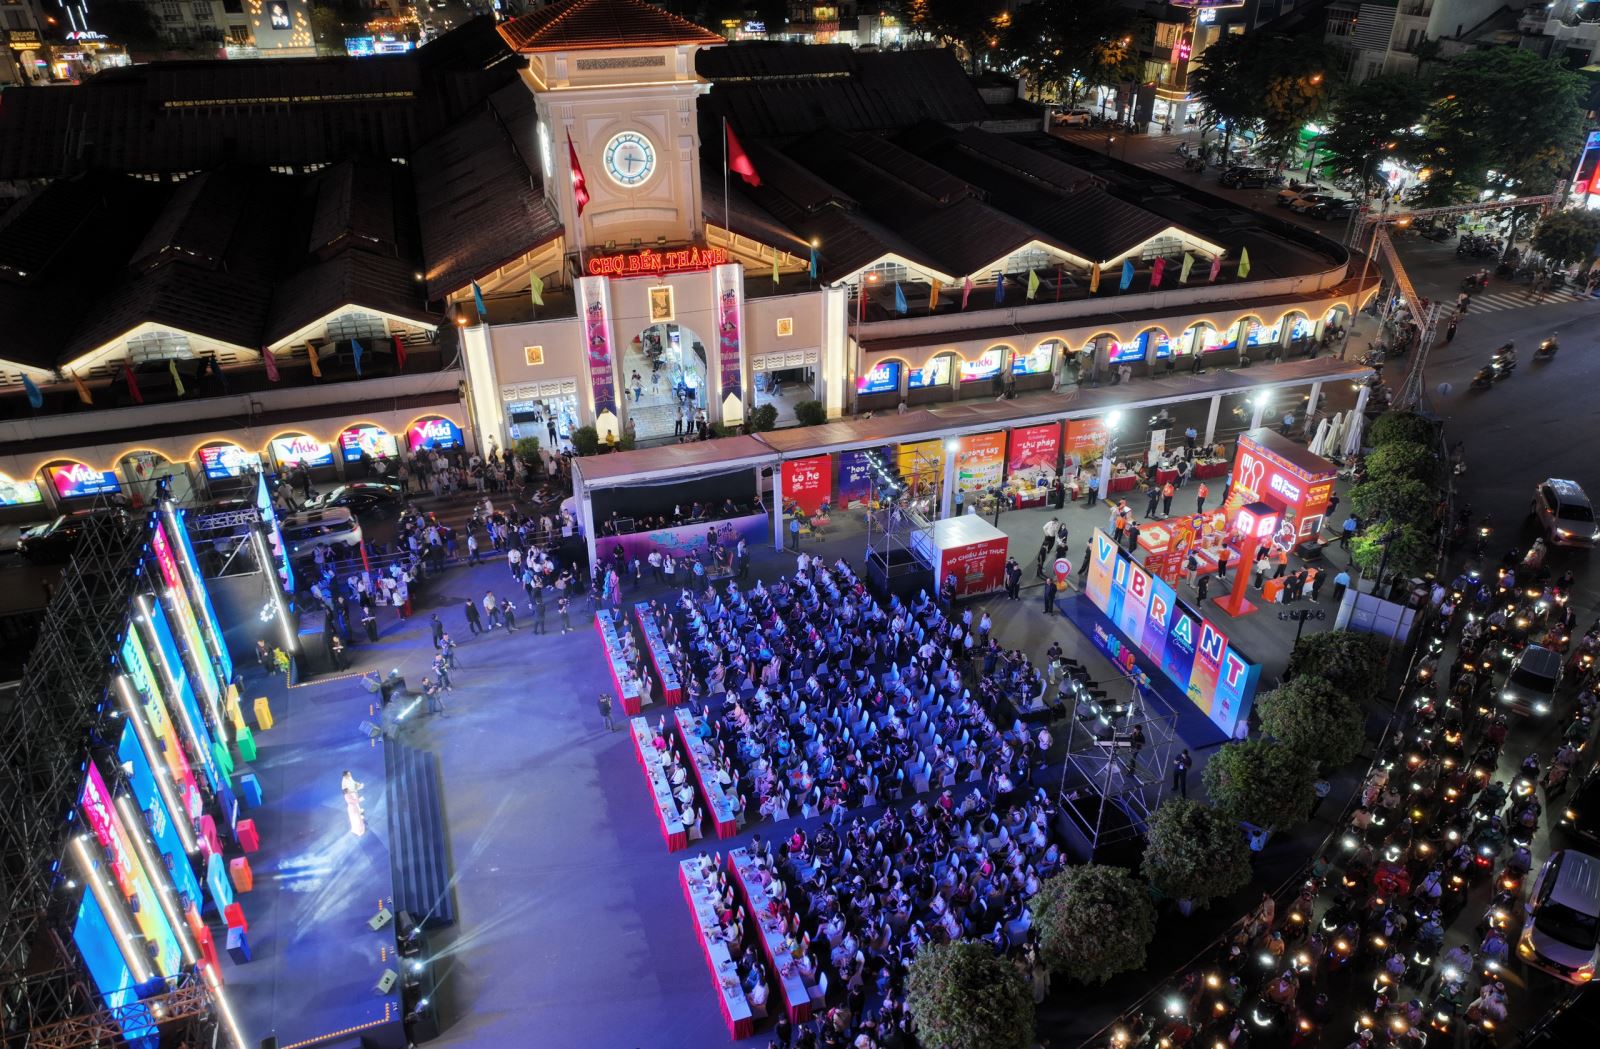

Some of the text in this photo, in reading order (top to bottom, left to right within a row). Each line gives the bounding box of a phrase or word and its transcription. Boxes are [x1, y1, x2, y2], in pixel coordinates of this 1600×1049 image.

[624, 134, 634, 142] 12
[589, 254, 625, 275] CHỢ
[628, 249, 662, 271] BẾN
[415, 421, 451, 439] Vikki
[281, 437, 319, 456] Vikki
[717, 522, 732, 538] CMC
[1098, 535, 1245, 688] VIBRANT
